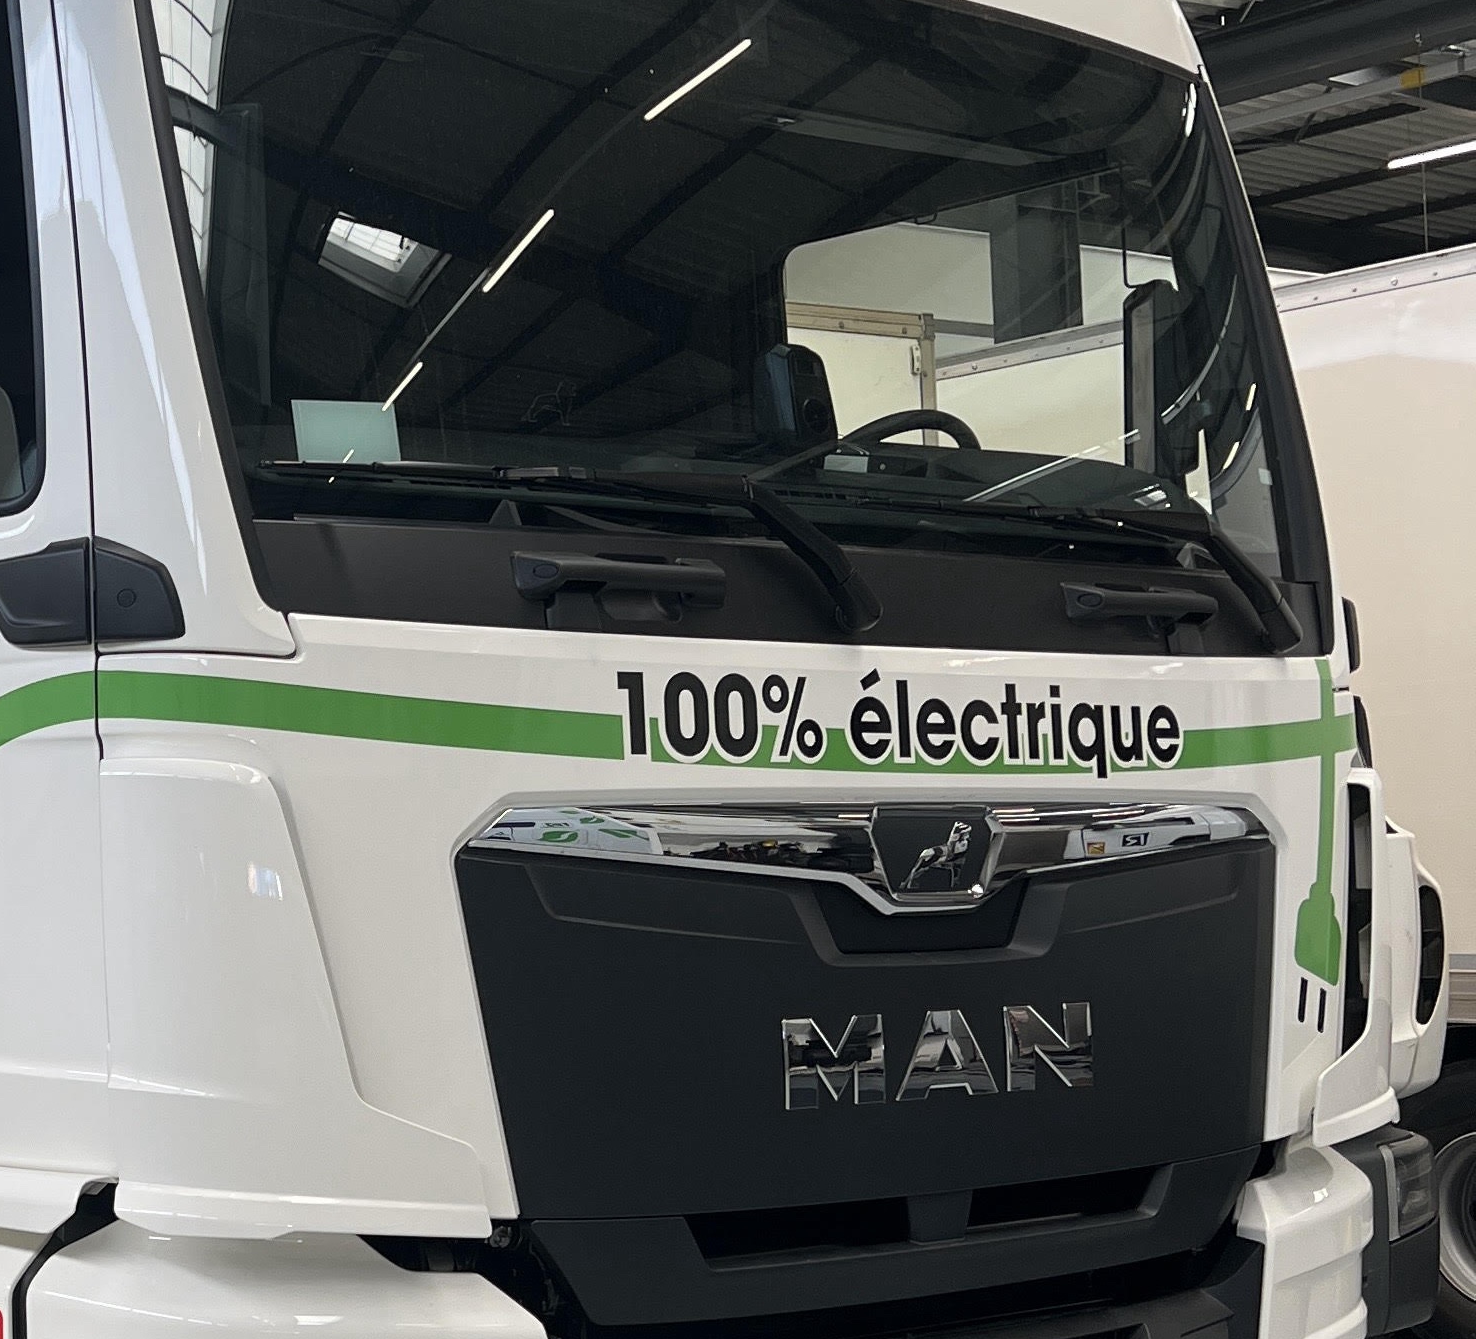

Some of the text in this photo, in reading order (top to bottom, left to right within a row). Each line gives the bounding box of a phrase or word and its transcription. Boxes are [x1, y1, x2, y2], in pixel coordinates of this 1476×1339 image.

[616, 668, 1182, 778] 100% électrique
[781, 1002, 1094, 1111] MAN
